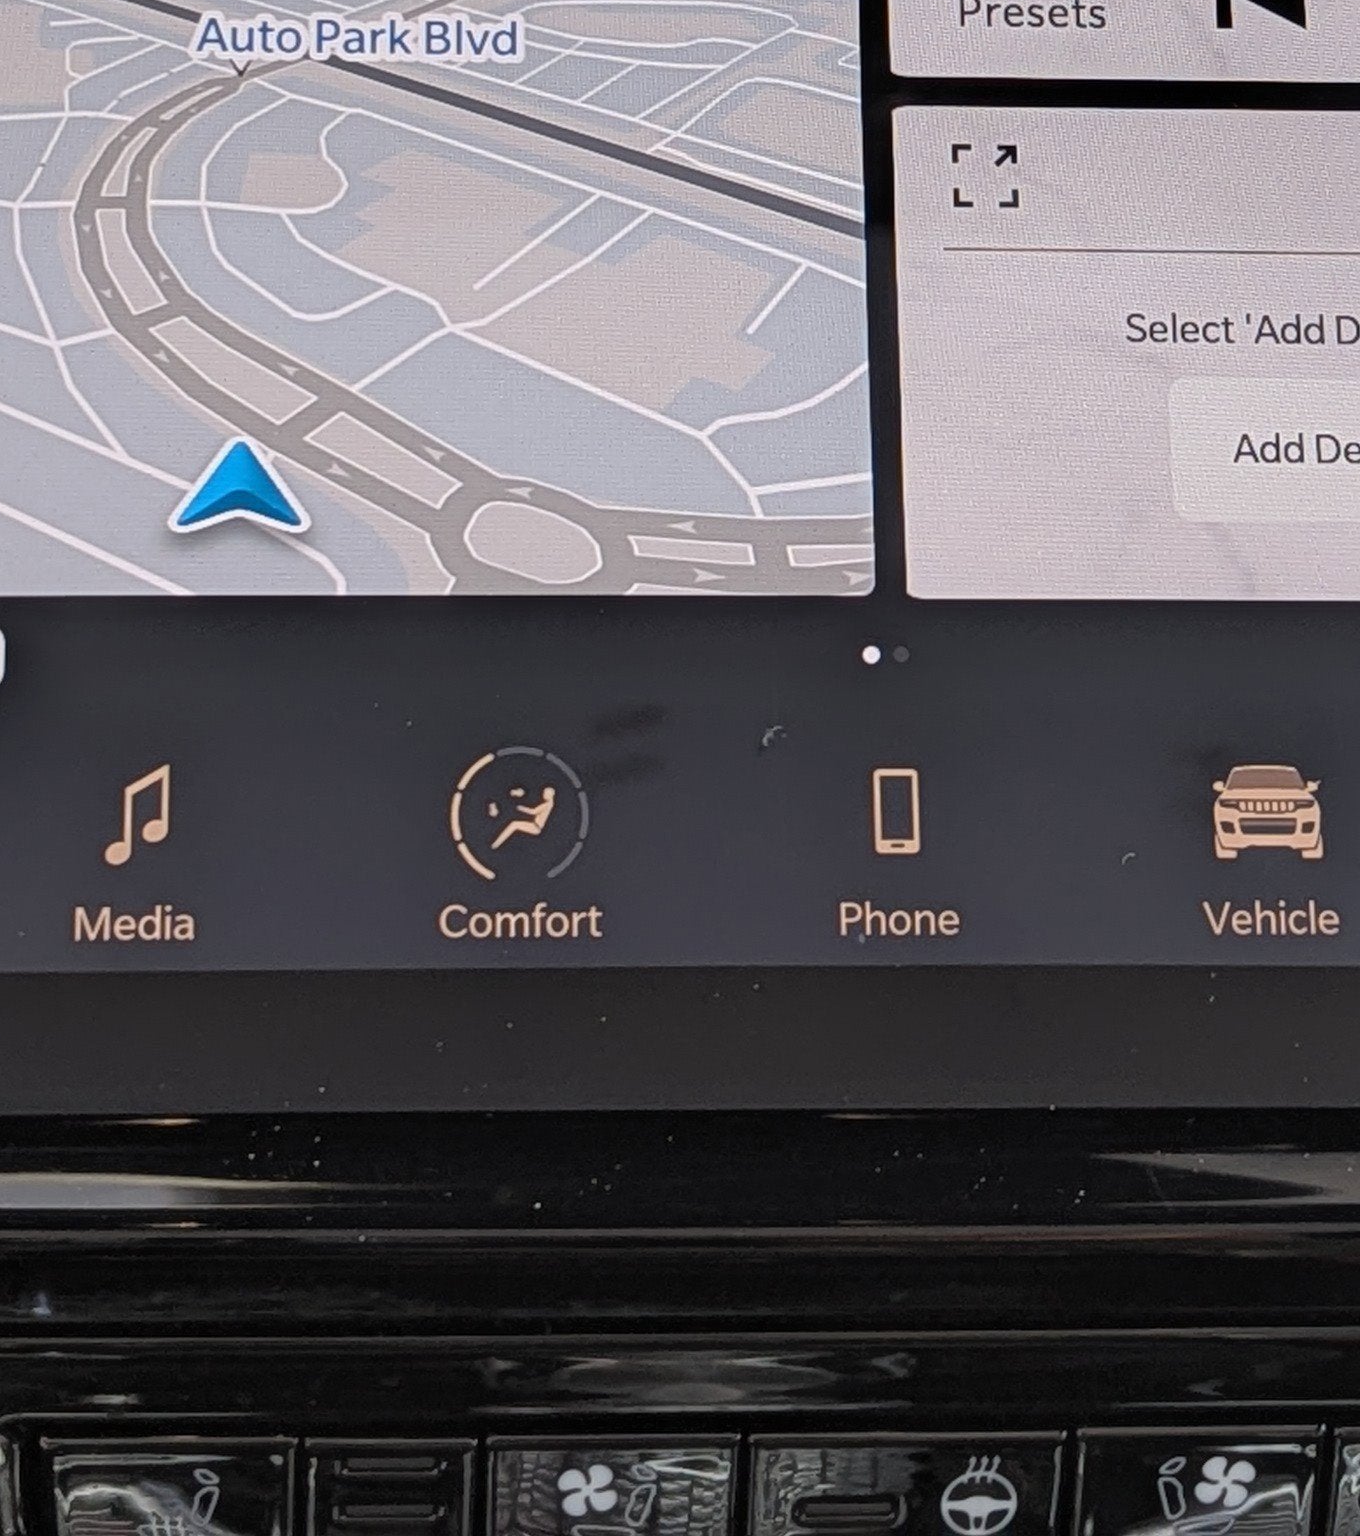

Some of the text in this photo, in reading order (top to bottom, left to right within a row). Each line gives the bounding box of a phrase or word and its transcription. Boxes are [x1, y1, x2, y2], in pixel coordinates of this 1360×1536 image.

[197, 17, 518, 57] Auto Park Blvd
[1126, 313, 1235, 344] Select
[1245, 314, 1325, 345] 'Add
[1234, 433, 1304, 465] Add
[74, 906, 195, 941] Media
[439, 902, 603, 938] Comfort
[839, 901, 960, 937] Phone
[1203, 900, 1340, 936] Vehicle
